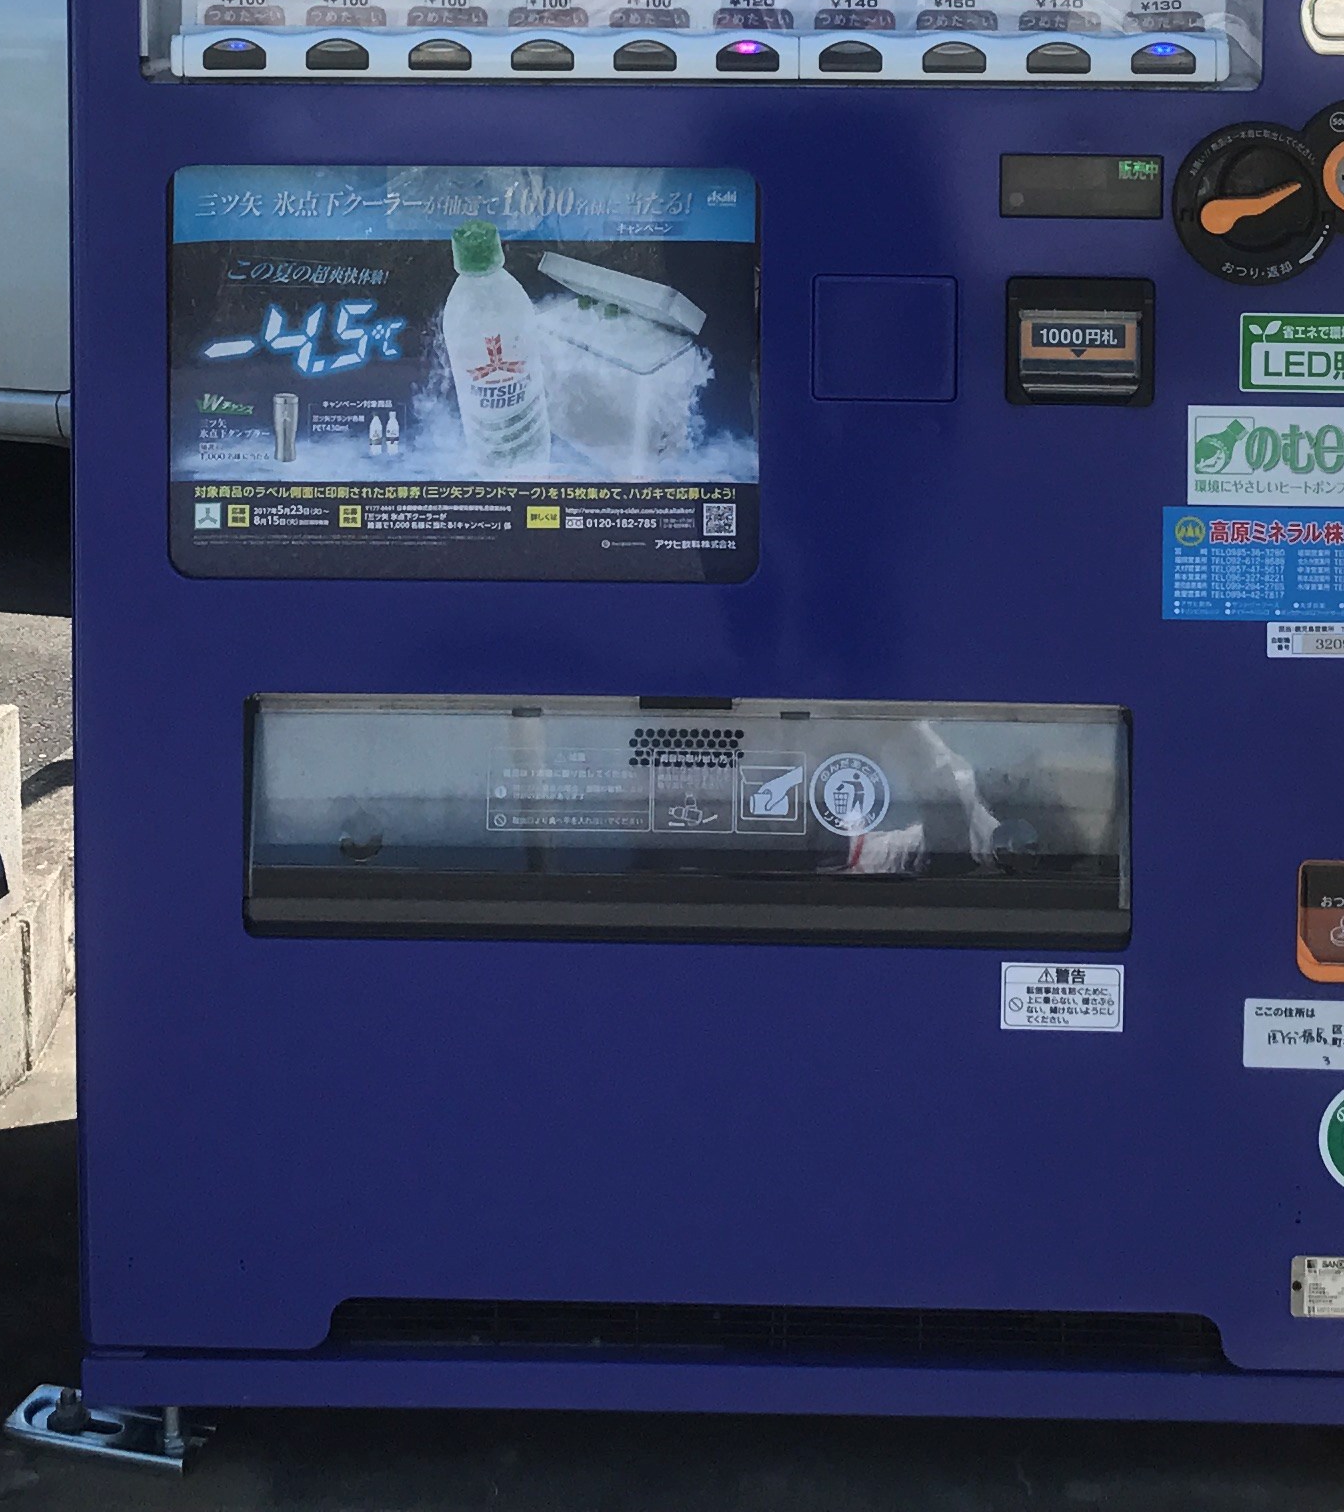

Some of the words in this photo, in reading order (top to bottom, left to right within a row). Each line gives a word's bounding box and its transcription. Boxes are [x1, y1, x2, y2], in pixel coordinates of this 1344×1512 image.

[1141, 0, 1182, 11] ¥130
[1118, 160, 1159, 181] 販売中
[195, 190, 263, 218] 三ツ矢
[616, 223, 672, 235] キャンペーン
[227, 260, 391, 286] この夏の超爽快体験!
[1221, 260, 1293, 279] おつり・返却
[1039, 328, 1118, 346] 1000円札
[479, 392, 526, 409] CIDER
[586, 518, 657, 529] 0120-182-785
[1055, 968, 1086, 985] 警告
[1026, 1015, 1070, 1025] てください。
[1254, 1006, 1316, 1019] ここの住所は
